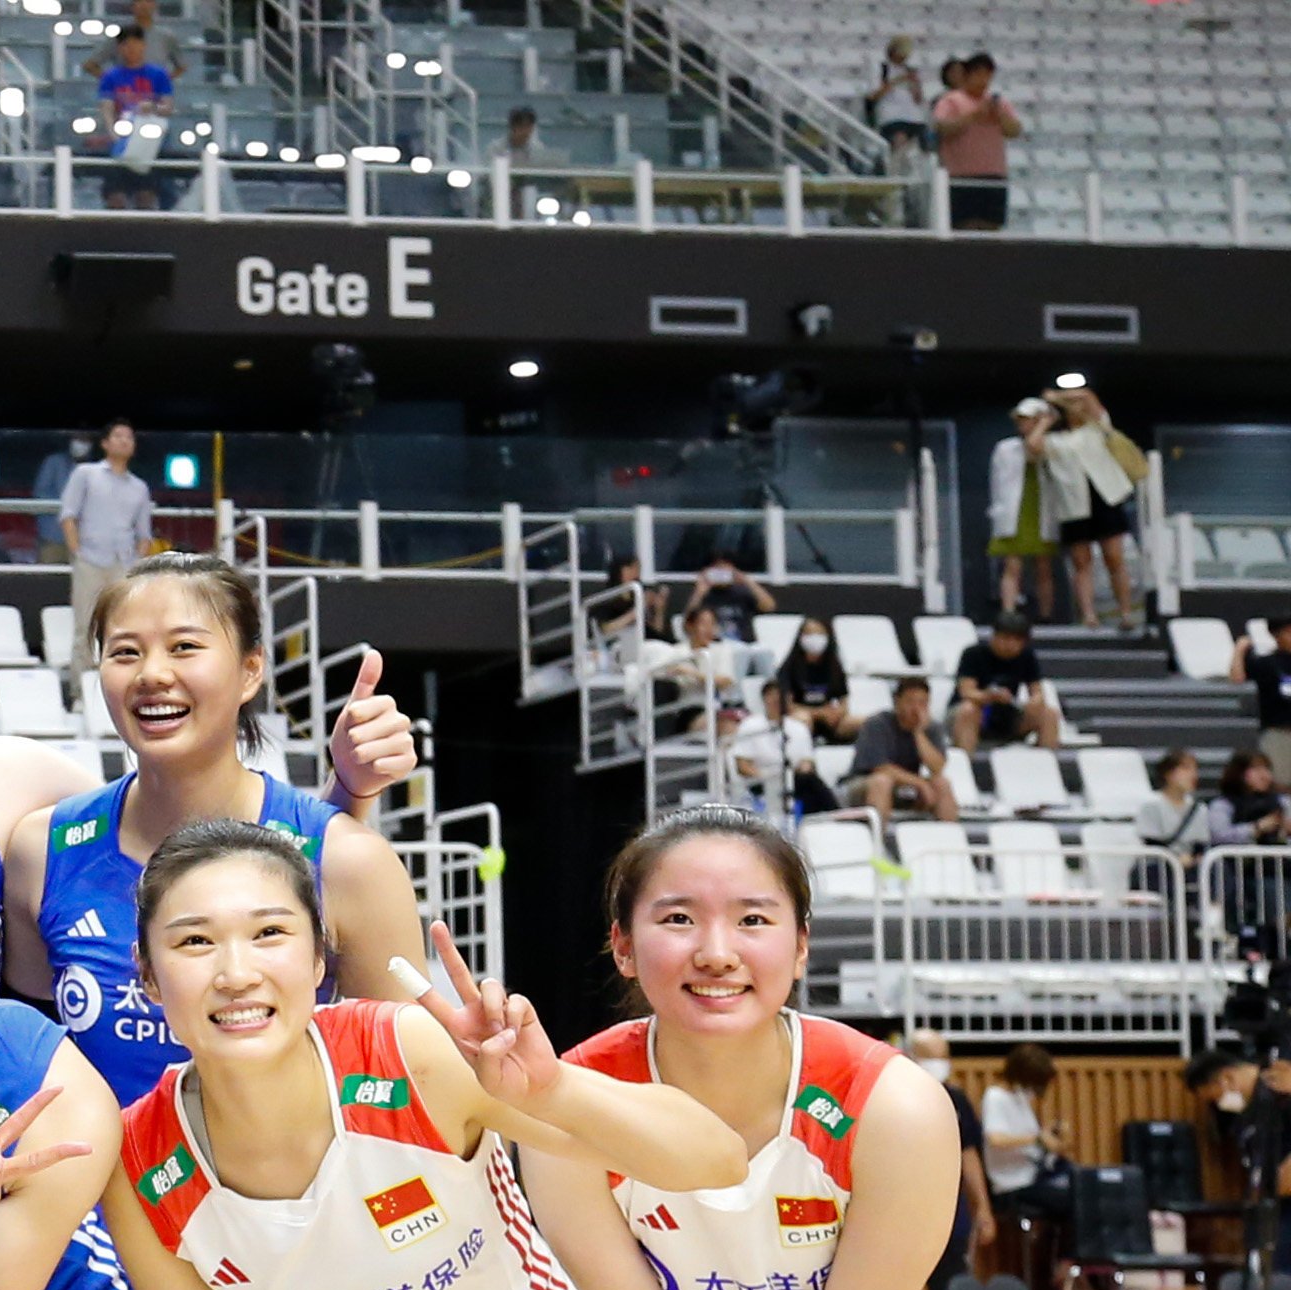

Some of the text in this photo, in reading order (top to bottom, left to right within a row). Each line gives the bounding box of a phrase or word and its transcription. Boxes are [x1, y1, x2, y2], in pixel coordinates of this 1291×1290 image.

[237, 236, 435, 320] Gate E
[355, 1078, 395, 1106] 怡寶
[806, 1096, 844, 1130] 怡寶
[151, 1155, 185, 1197] 怡寶
[390, 1211, 441, 1245] CHN
[787, 1227, 839, 1245] CHN
